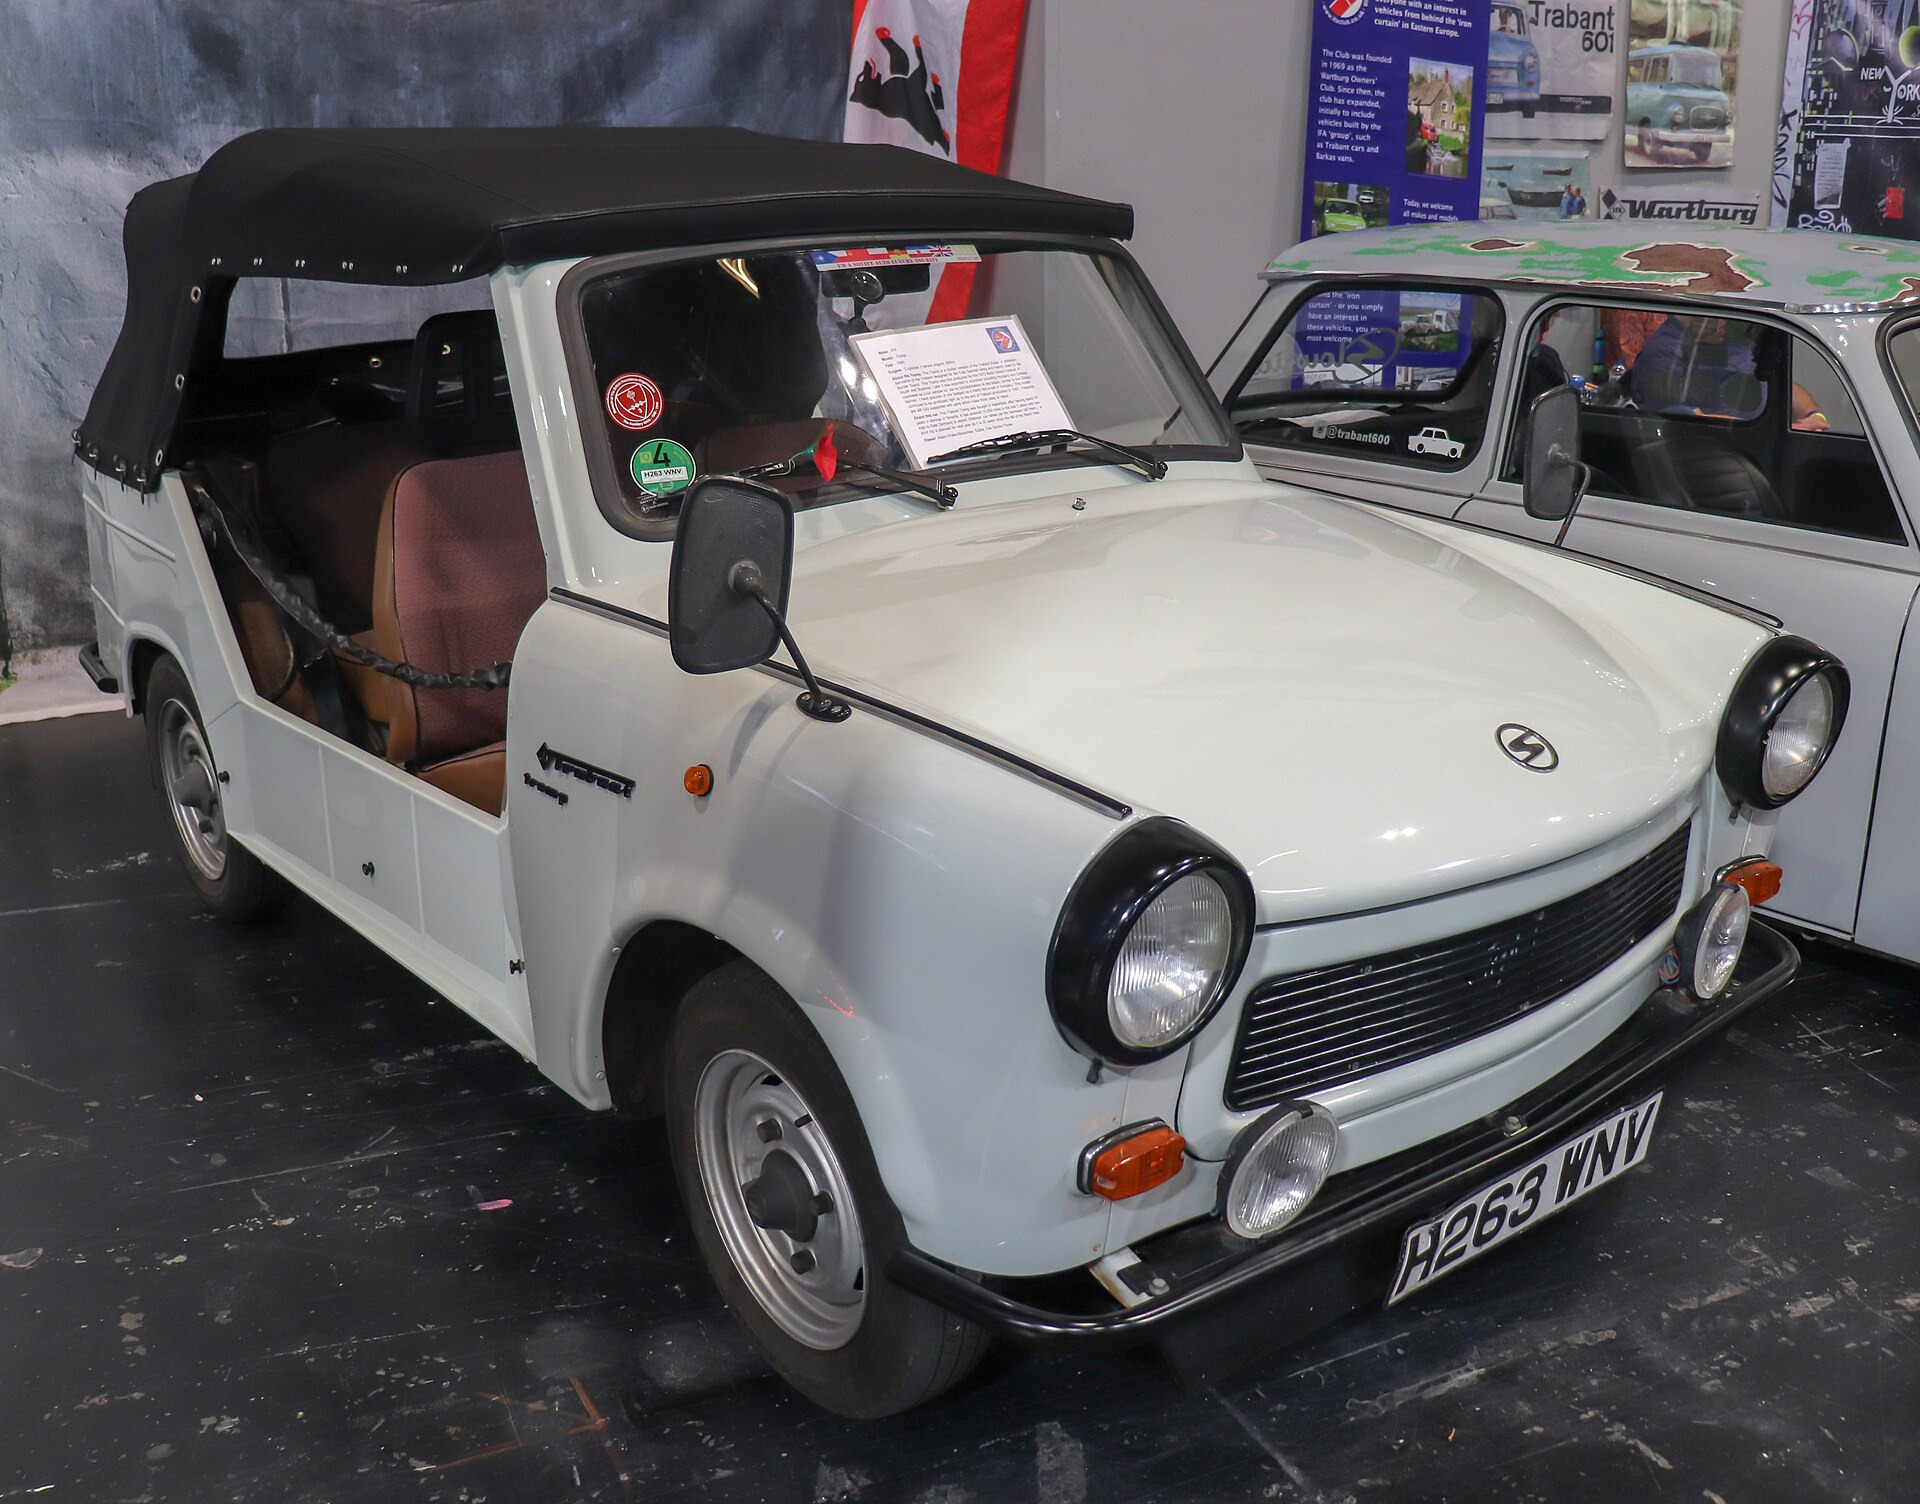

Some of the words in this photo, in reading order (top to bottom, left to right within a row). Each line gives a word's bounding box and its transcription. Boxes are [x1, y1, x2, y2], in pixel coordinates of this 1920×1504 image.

[1374, 6, 1403, 17] vehicles
[1404, 9, 1420, 19] from
[1421, 13, 1444, 24] behind
[1445, 17, 1456, 26] the
[1433, 5, 1459, 15] interest
[1460, 8, 1467, 16] in
[1528, 0, 1615, 31] Trabant
[1402, 21, 1409, 29] in
[1411, 22, 1434, 33] Eastern
[1435, 26, 1460, 37] Europe.
[1582, 31, 1614, 53] 601
[1323, 49, 1334, 57] The
[1335, 50, 1350, 59] Club
[1366, 53, 1392, 64] founded
[1330, 61, 1346, 70] 1969
[1356, 64, 1367, 73] the
[1321, 72, 1350, 84] Wartburg
[1350, 75, 1378, 85] Owners'
[1860, 67, 1884, 80] NEW
[1320, 83, 1336, 92] Club.
[1337, 85, 1355, 94] Since
[1356, 87, 1373, 97] then,
[1374, 89, 1385, 98] the
[1319, 95, 1333, 104] club
[1333, 96, 1345, 105] has
[1346, 99, 1381, 109] expanded,
[1319, 108, 1341, 117] initially
[1351, 111, 1375, 119] include
[1318, 119, 1342, 127] vehicles
[1344, 120, 1360, 129] built
[1361, 122, 1369, 131] by
[1370, 123, 1382, 131] the
[1317, 129, 1327, 137] IFA
[1325, 141, 1350, 151] Trabant
[1316, 152, 1336, 161] Barkas
[1337, 154, 1355, 163] vans.
[1404, 199, 1421, 208] Today,
[1430, 203, 1453, 211] welcome
[1621, 200, 1759, 225] Wartburg
[1332, 291, 1343, 299] the
[1361, 304, 1384, 313] simply
[1307, 312, 1323, 320] have
[1333, 313, 1359, 321] interest
[1307, 323, 1324, 331] these
[1326, 425, 1391, 446] @trabant600
[653, 442, 671, 467] 4
[644, 470, 663, 478] H263
[1393, 1162, 1548, 1297] H263
[1554, 1099, 1656, 1205] WNV
